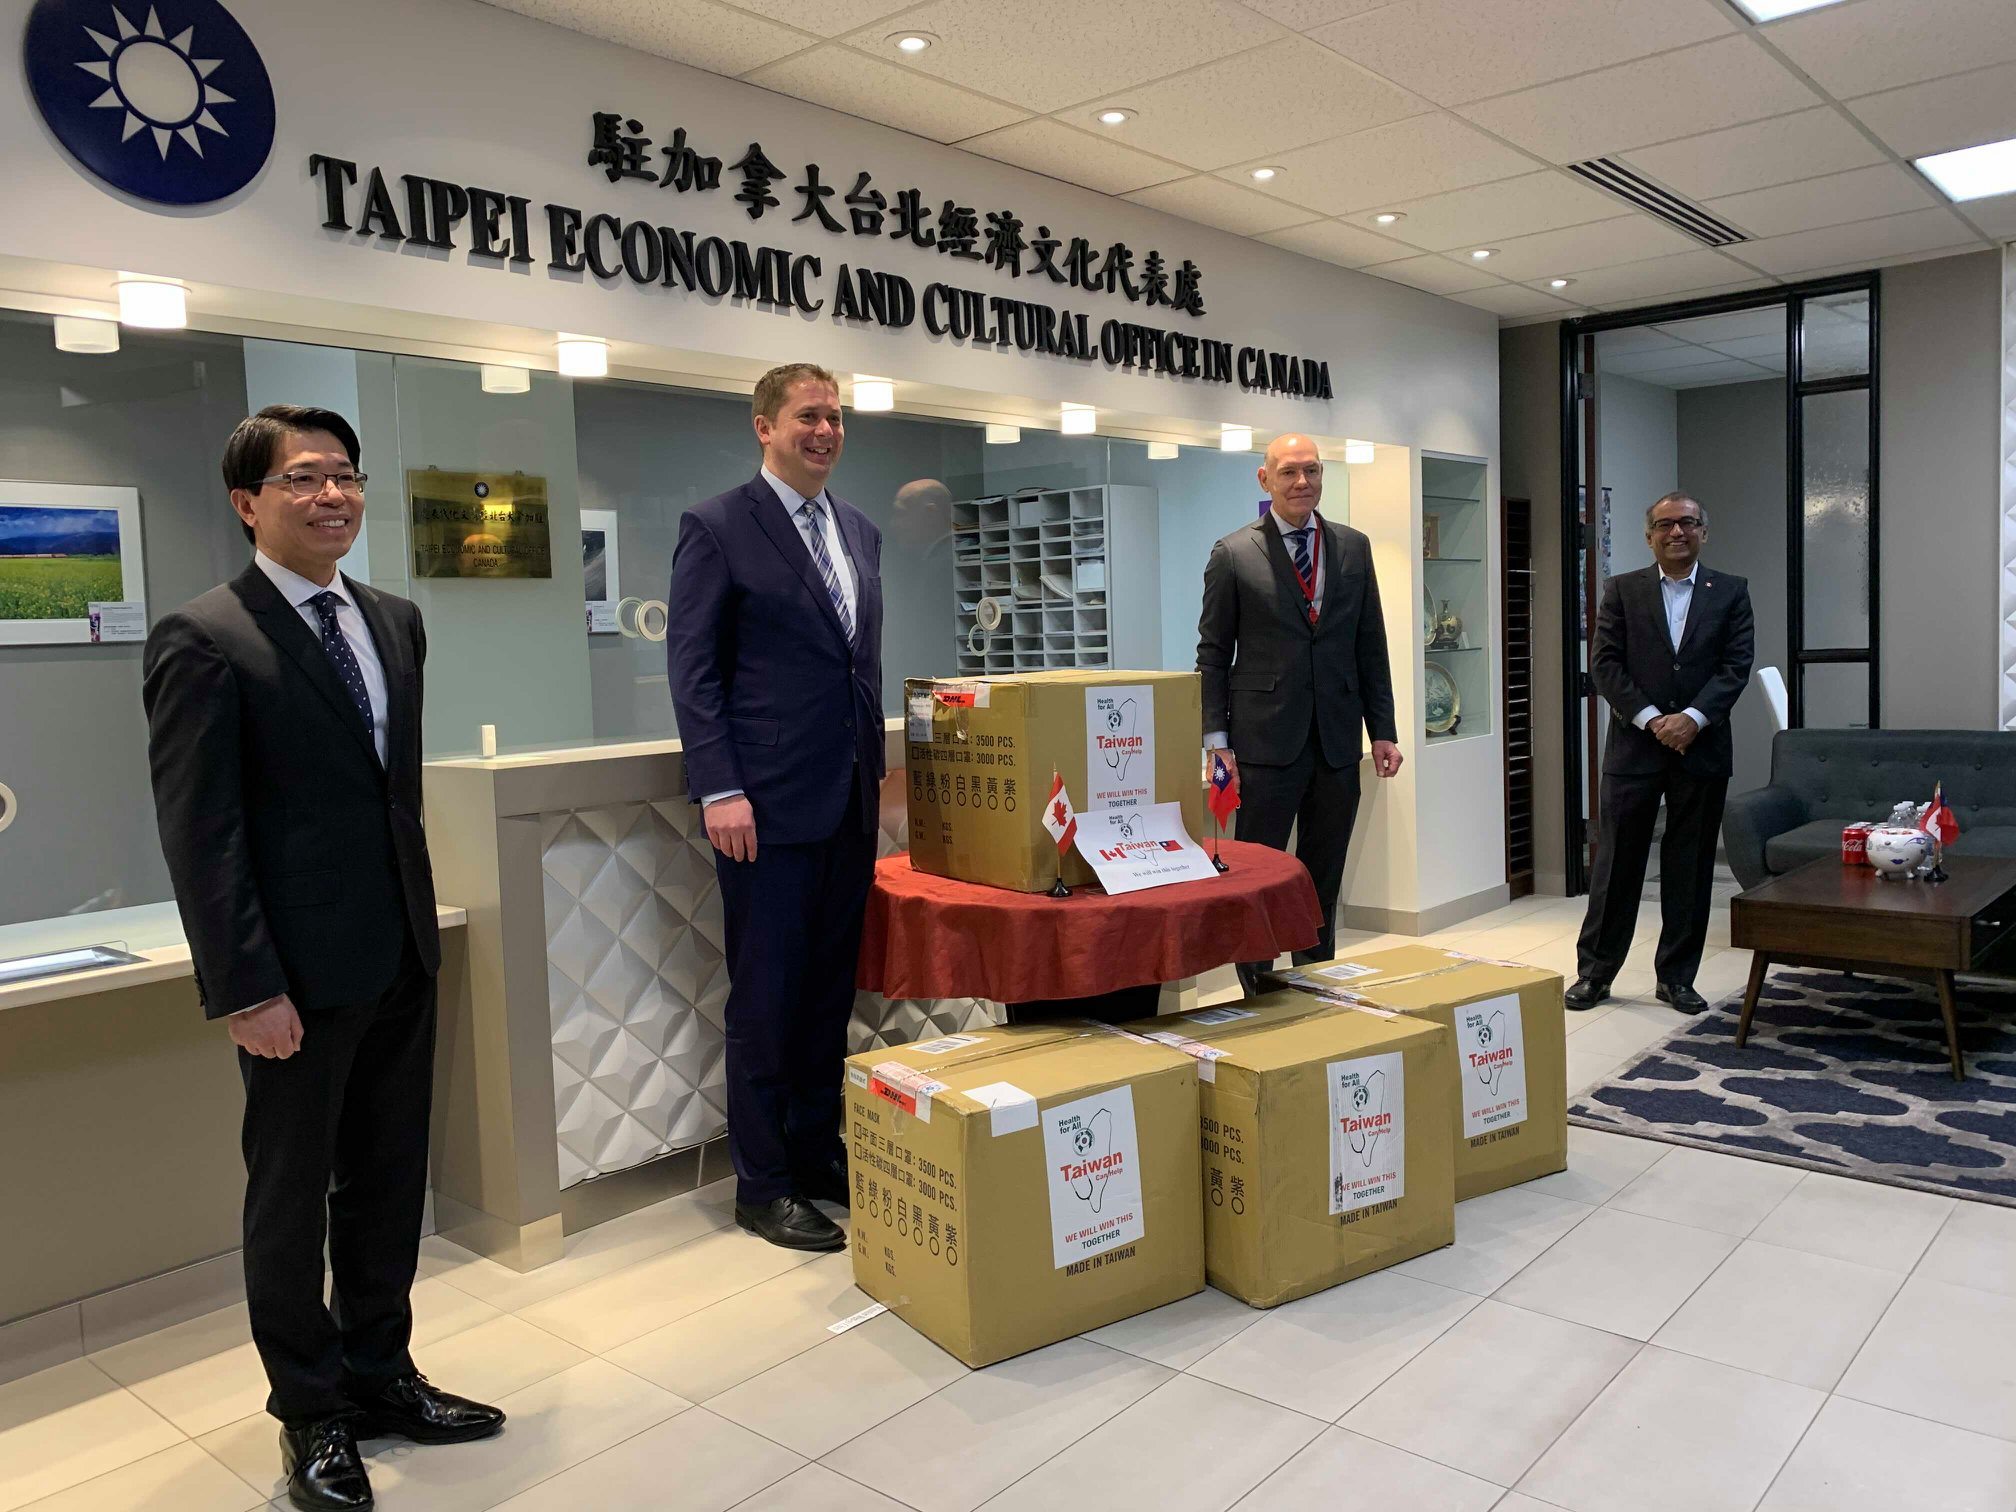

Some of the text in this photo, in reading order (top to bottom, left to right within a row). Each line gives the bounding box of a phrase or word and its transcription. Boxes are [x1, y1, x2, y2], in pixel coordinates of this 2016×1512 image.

[588, 111, 1206, 317] 駐加拿大台北經濟文化代表處
[310, 153, 1333, 400] TAIPEI ECONOMIC AND CULTURAL OFFICE IN CANADA
[478, 545, 490, 554] AND
[473, 558, 499, 568] CANADA
[976, 735, 994, 747] 3500
[998, 736, 1016, 749] PCS.
[1096, 735, 1142, 749] Taiwan
[976, 753, 994, 765] 3000
[998, 754, 1016, 766] PCS.
[1107, 790, 1121, 798] WILL
[1122, 789, 1134, 797] WIN
[1134, 788, 1147, 796] THIS
[1108, 799, 1137, 808] TOGETHER
[1116, 839, 1158, 852] Taiwan
[1466, 1014, 1482, 1022] Health
[1469, 1047, 1513, 1068] Taiwan
[1341, 1073, 1360, 1081] Health
[854, 1102, 880, 1125] FACE MASK
[1472, 1099, 1520, 1118] WE WILL WIN THIS
[1483, 1111, 1511, 1124] TOGETHER
[1058, 1115, 1081, 1127] Health
[1072, 1122, 1081, 1131] All
[1340, 1113, 1391, 1133] Taiwan
[1223, 1124, 1244, 1143] PCS.
[1470, 1126, 1520, 1148] MADE IN TAIWAN
[1223, 1145, 1244, 1164] PCS.
[918, 1158, 936, 1178] 3500
[939, 1168, 957, 1189] PCS.
[1060, 1151, 1123, 1182] Taiwan
[1095, 1167, 1123, 1181] Can Help
[1351, 1179, 1367, 1189] WILL
[1368, 1176, 1381, 1185] WIN
[1382, 1172, 1396, 1181] THIS
[918, 1180, 936, 1200] 3000
[939, 1190, 957, 1212] PCS.
[1353, 1186, 1385, 1200] TOGETHER
[1340, 1199, 1397, 1226] MADE IN TAIWAN
[1065, 1212, 1133, 1243] WE WILL WIN THIS
[1082, 1229, 1120, 1249] TOGETHER
[1066, 1246, 1136, 1277] MADE IN TAIWAN
